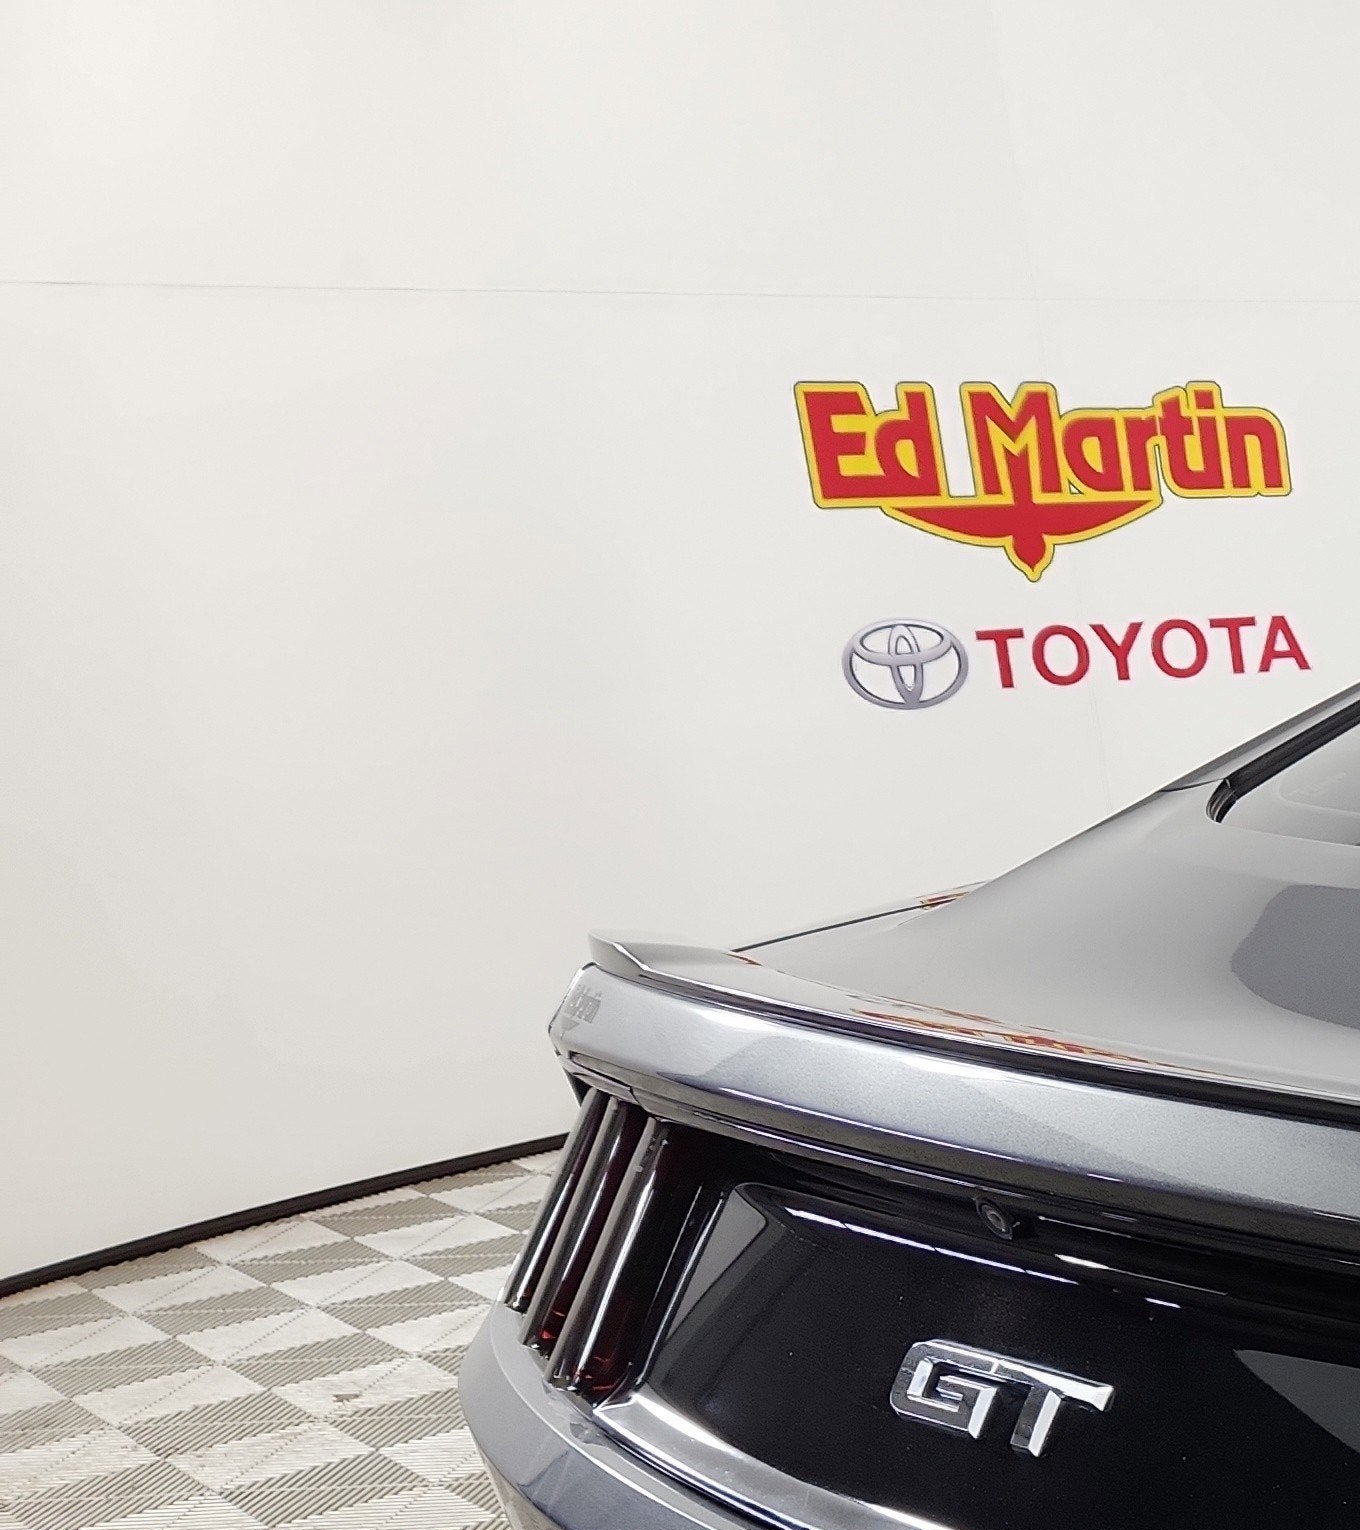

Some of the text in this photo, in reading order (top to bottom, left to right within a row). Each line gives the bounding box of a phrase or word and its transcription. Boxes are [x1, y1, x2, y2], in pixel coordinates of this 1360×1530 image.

[798, 386, 1288, 502] Ed Martin
[974, 614, 1312, 690] TOYOTA
[889, 1338, 1115, 1458] GT
